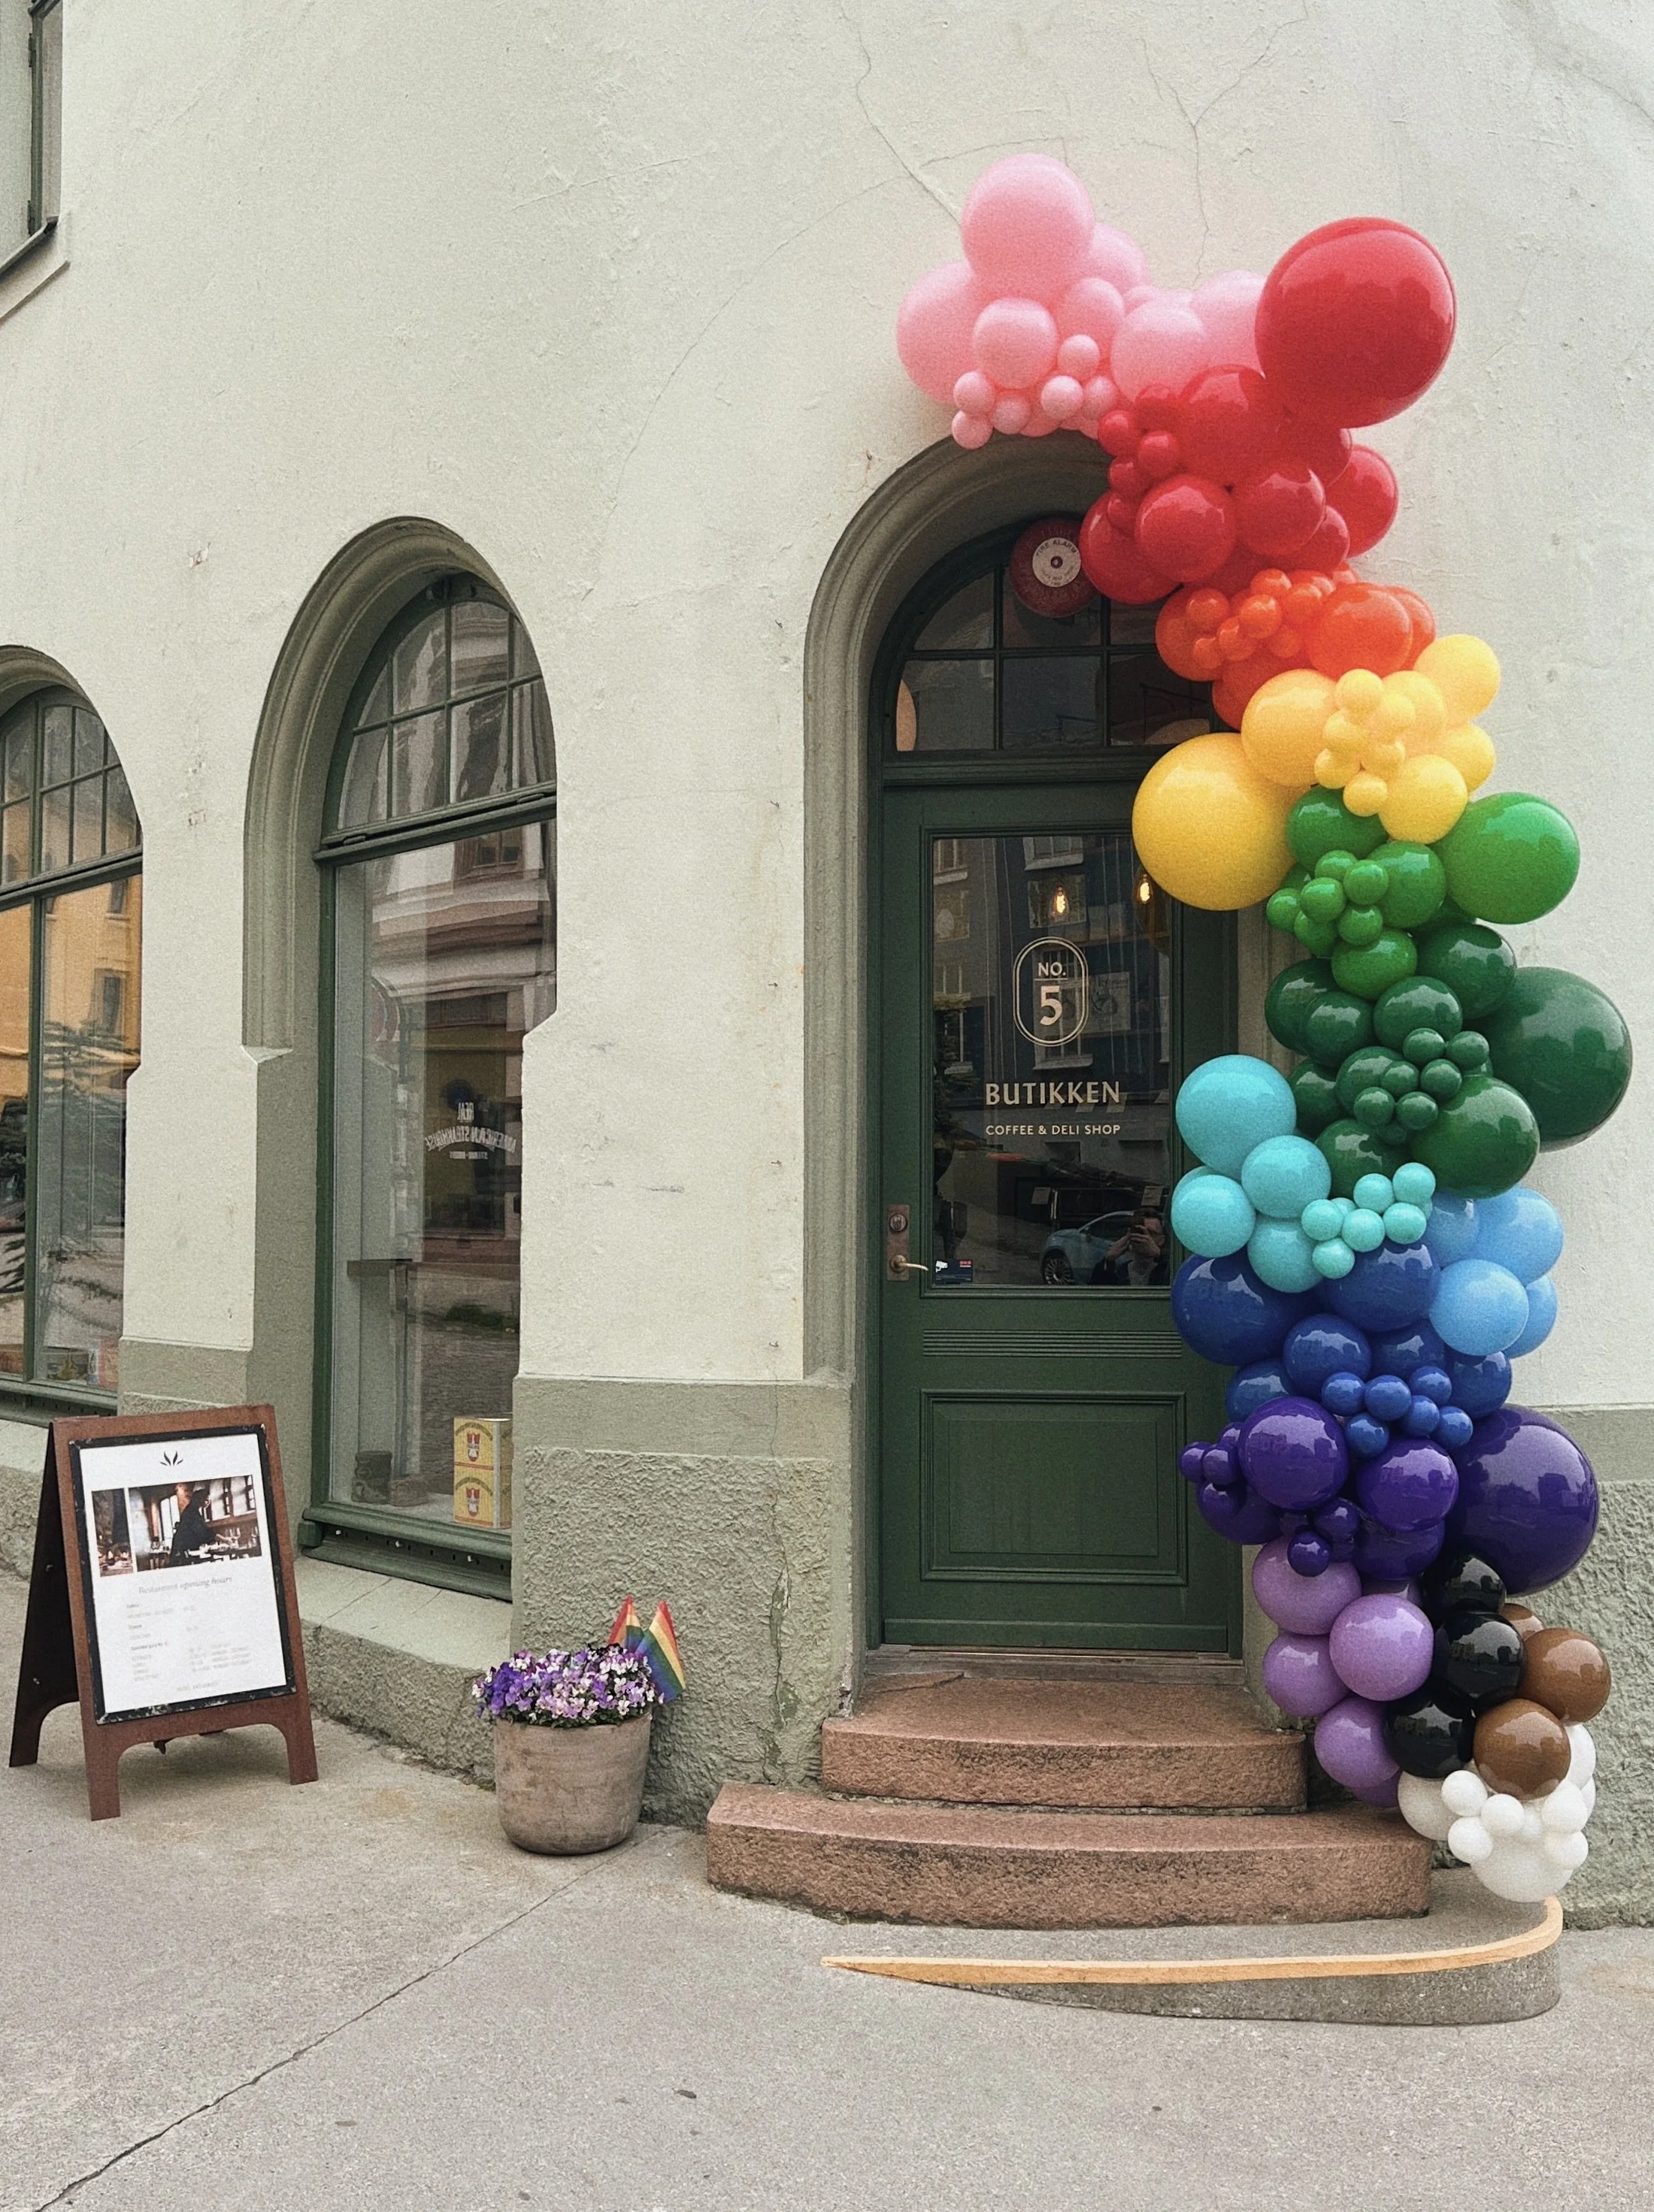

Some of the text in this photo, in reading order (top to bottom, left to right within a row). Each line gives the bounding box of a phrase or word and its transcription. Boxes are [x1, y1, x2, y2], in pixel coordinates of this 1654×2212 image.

[1053, 539, 1077, 553] ALARM
[1038, 961, 1067, 976] NO.
[1040, 985, 1063, 1026] 5
[986, 1081, 1120, 1106] BUTIKKEN
[986, 1124, 1120, 1136] COFFEE & DELI SHOP
